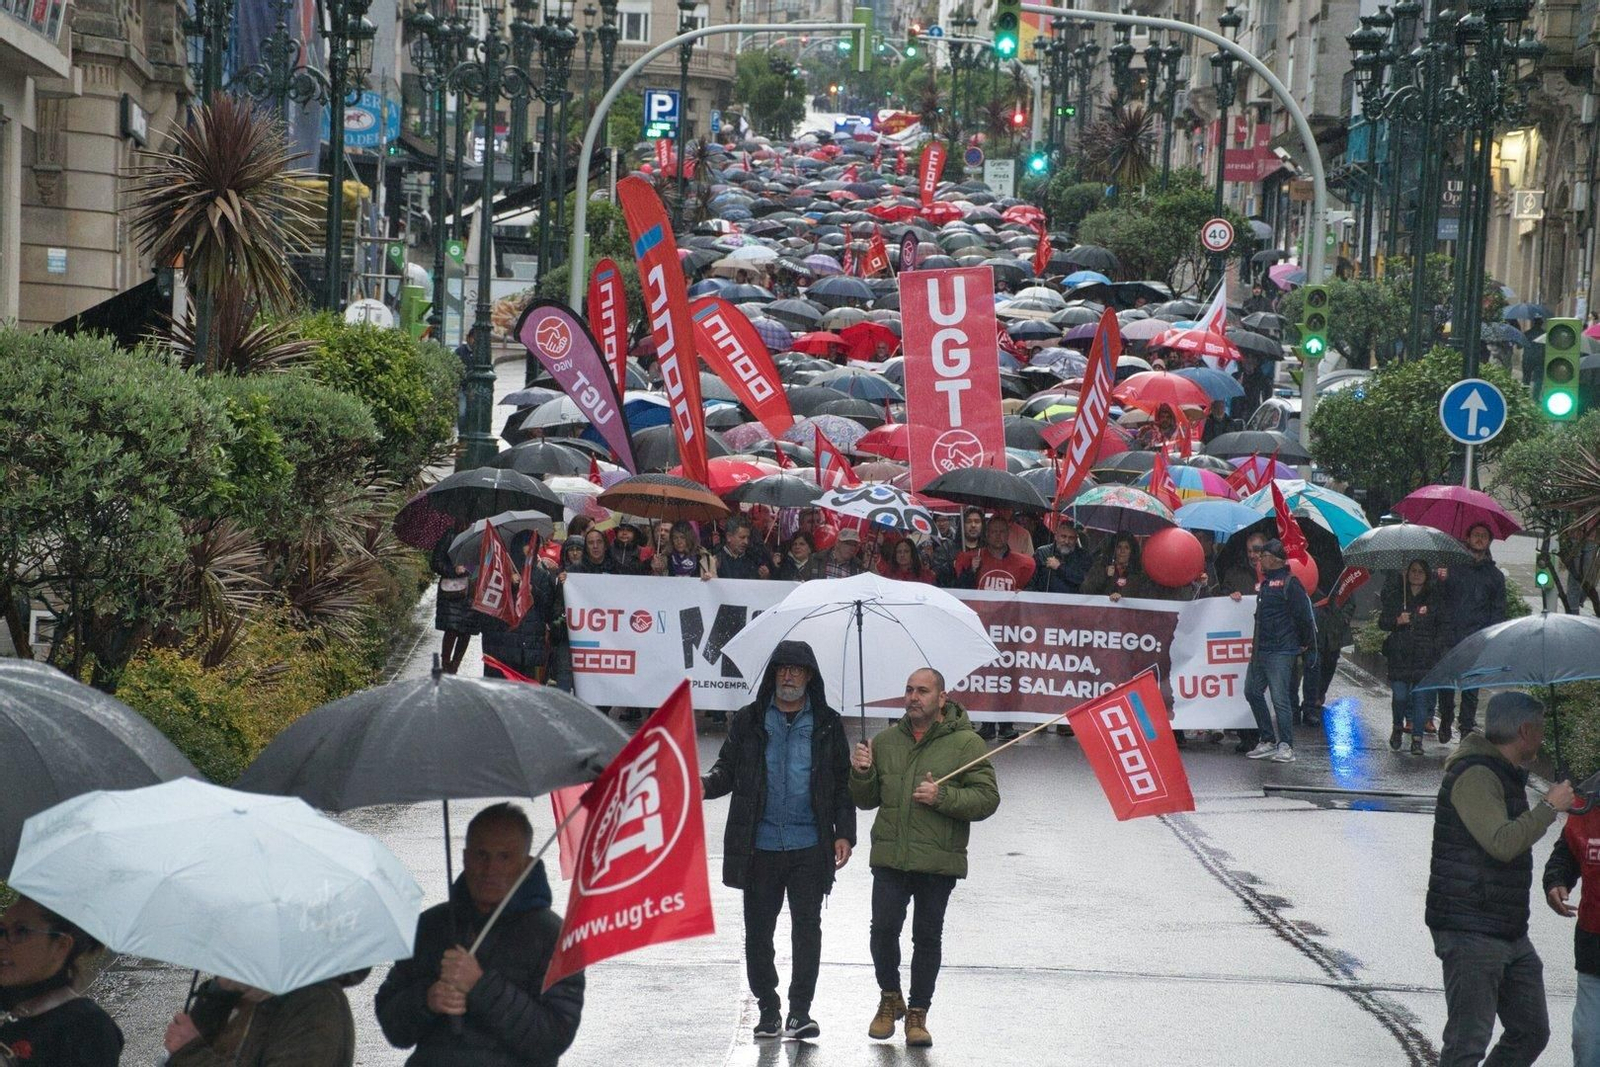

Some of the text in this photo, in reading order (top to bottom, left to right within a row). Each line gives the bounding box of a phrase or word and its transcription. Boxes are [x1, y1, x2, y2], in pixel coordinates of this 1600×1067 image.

[651, 94, 674, 120] P
[1225, 162, 1254, 170] arenal
[1209, 229, 1227, 239] 40
[648, 264, 694, 444] CCOO
[702, 313, 775, 403] CCOO
[926, 276, 971, 428] UGT
[567, 607, 625, 632] UGT
[989, 625, 1162, 653] ENO EMPREGO:
[571, 652, 632, 670] CCOO
[689, 679, 750, 691] PLENOEMPR
[950, 675, 1125, 699] ORES SALARIO
[1179, 674, 1238, 699] UGT
[1100, 705, 1158, 796] CCOO
[561, 891, 686, 952] www.ugt.es
